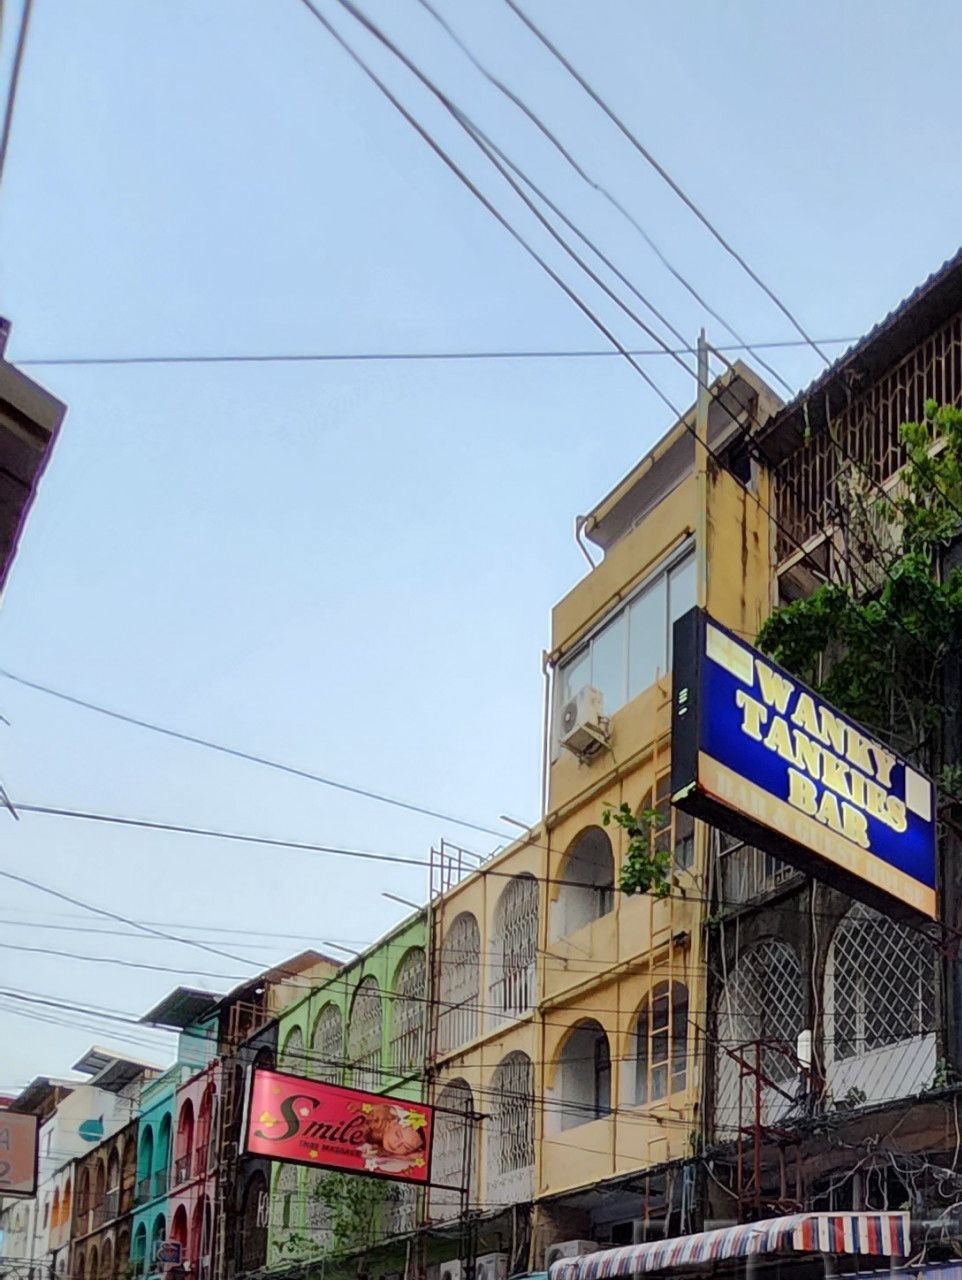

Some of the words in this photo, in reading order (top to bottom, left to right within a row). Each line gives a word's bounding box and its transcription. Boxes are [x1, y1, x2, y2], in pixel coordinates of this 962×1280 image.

[736, 690, 908, 833] TANKIES
[754, 659, 900, 788] WANKY
[788, 768, 870, 849] BAR
[254, 1094, 366, 1146] Smile
